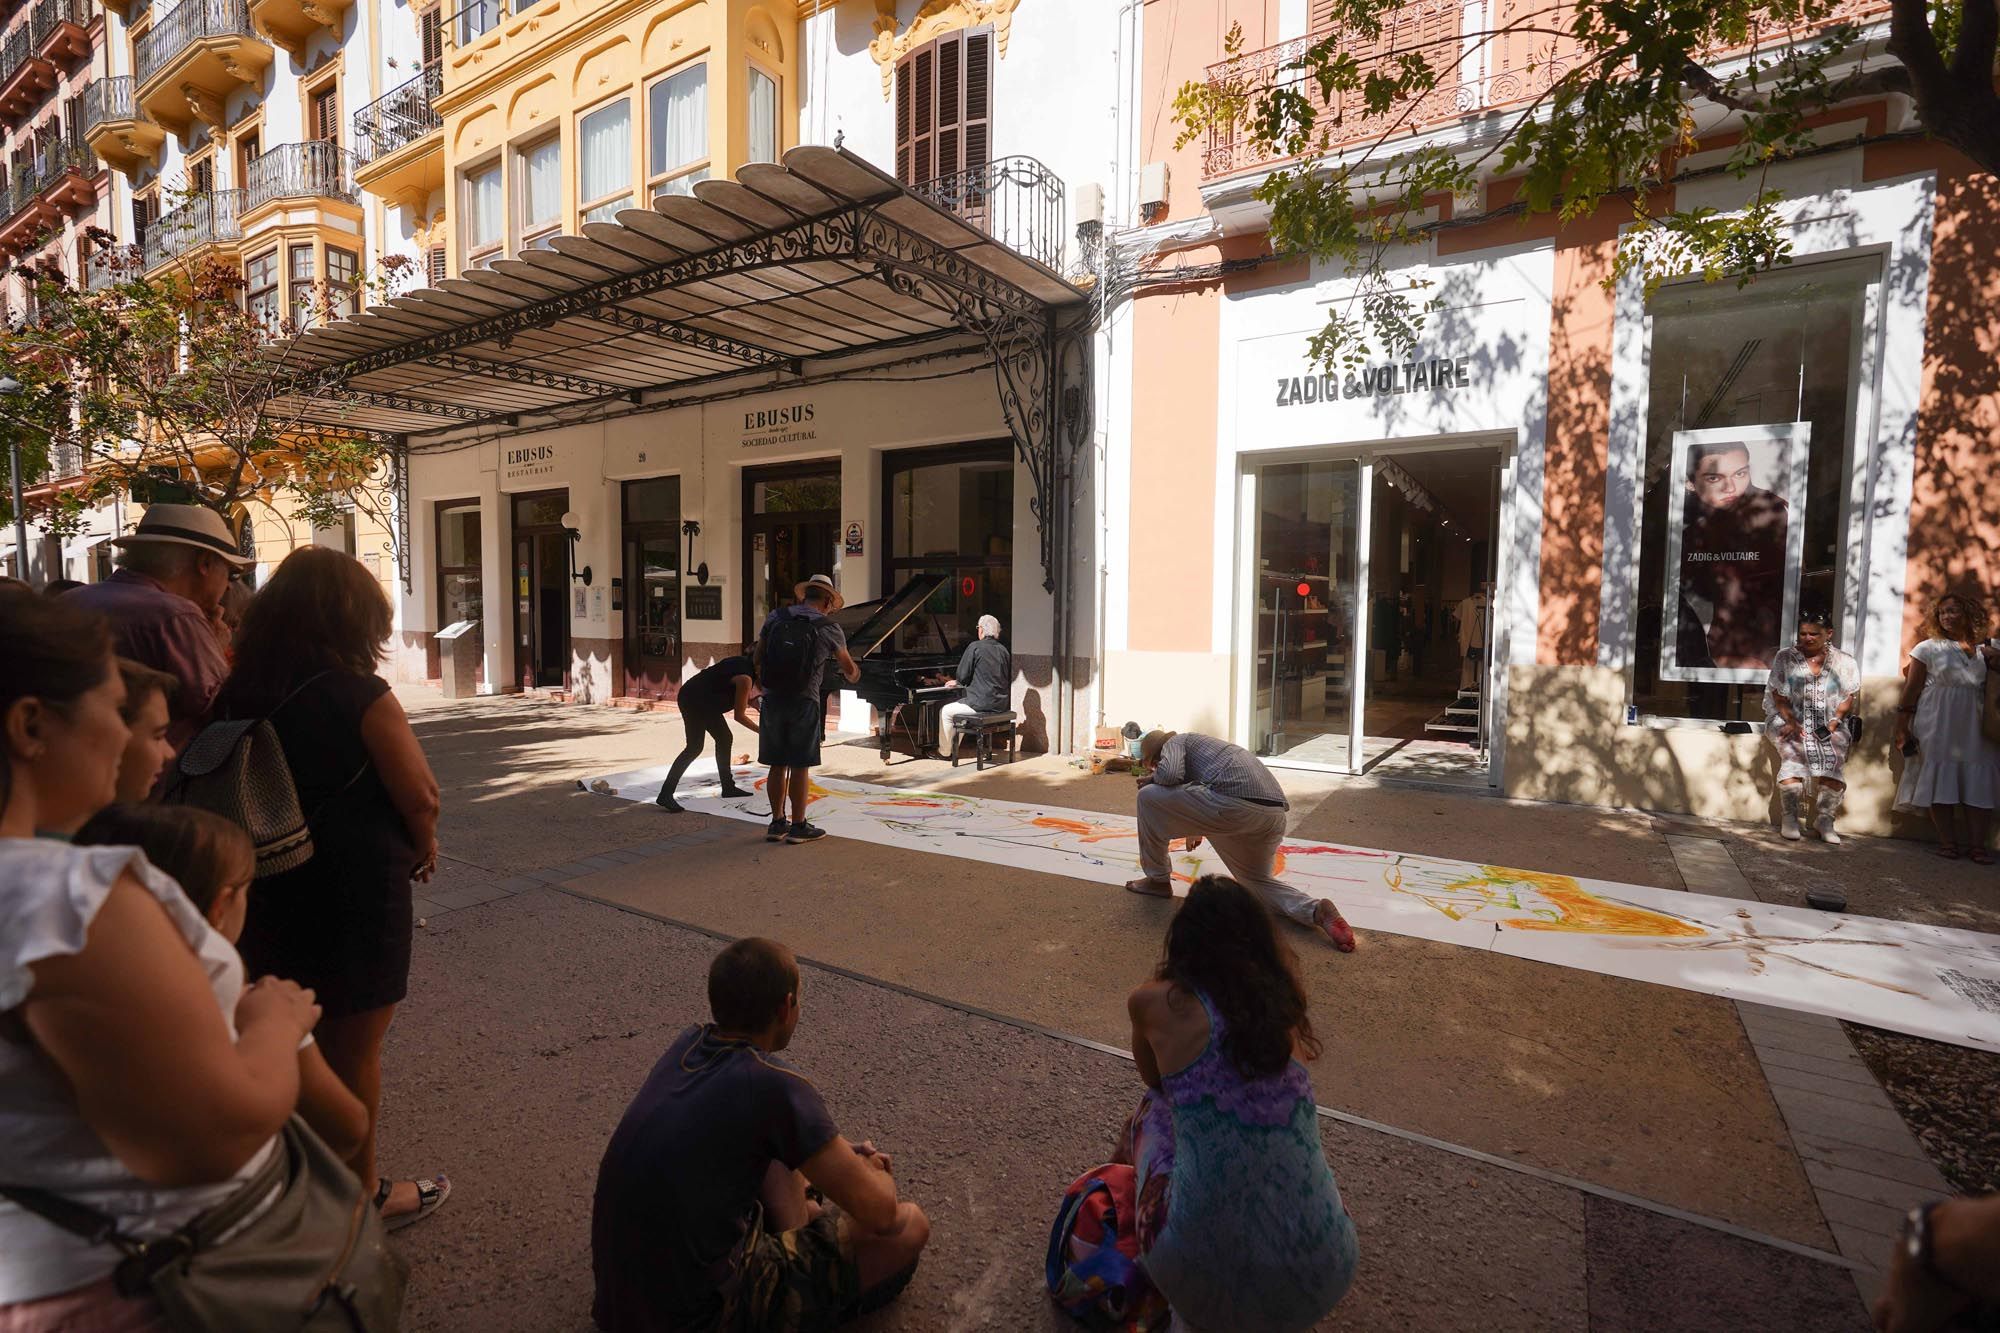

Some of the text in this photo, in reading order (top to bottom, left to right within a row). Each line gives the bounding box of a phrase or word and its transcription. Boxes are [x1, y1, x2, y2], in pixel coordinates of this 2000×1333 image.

[744, 403, 815, 430] EBUSUS
[741, 431, 817, 448] SOCIEDAD CULTURAL
[507, 445, 553, 465] EBUSUS
[507, 465, 553, 478] RESTAURANT
